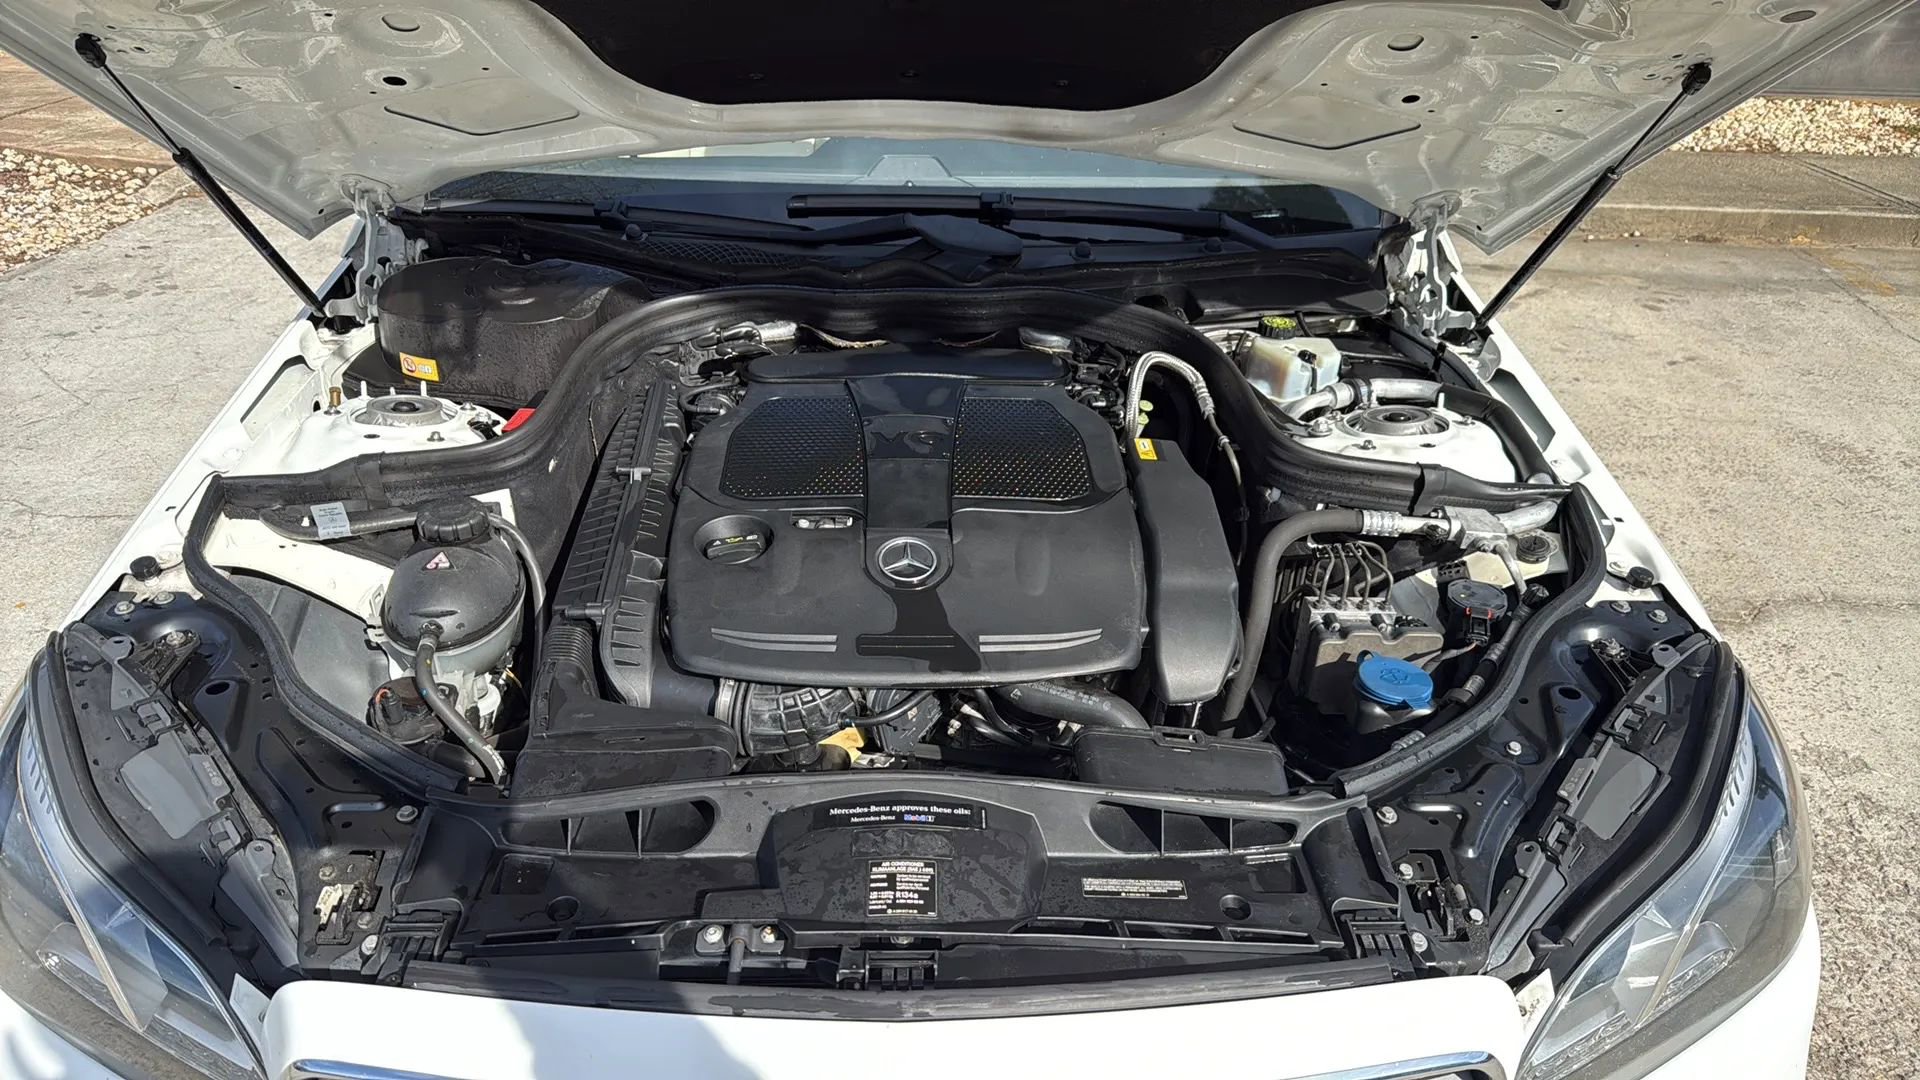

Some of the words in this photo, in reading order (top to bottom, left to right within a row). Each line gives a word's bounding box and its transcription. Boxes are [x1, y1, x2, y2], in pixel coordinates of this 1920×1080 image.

[829, 805, 890, 816] Mercedes-Benz
[892, 805, 928, 814] approves
[930, 805, 952, 814] these
[850, 815, 896, 823] Mercedes-Benz
[895, 891, 919, 899] R134a
